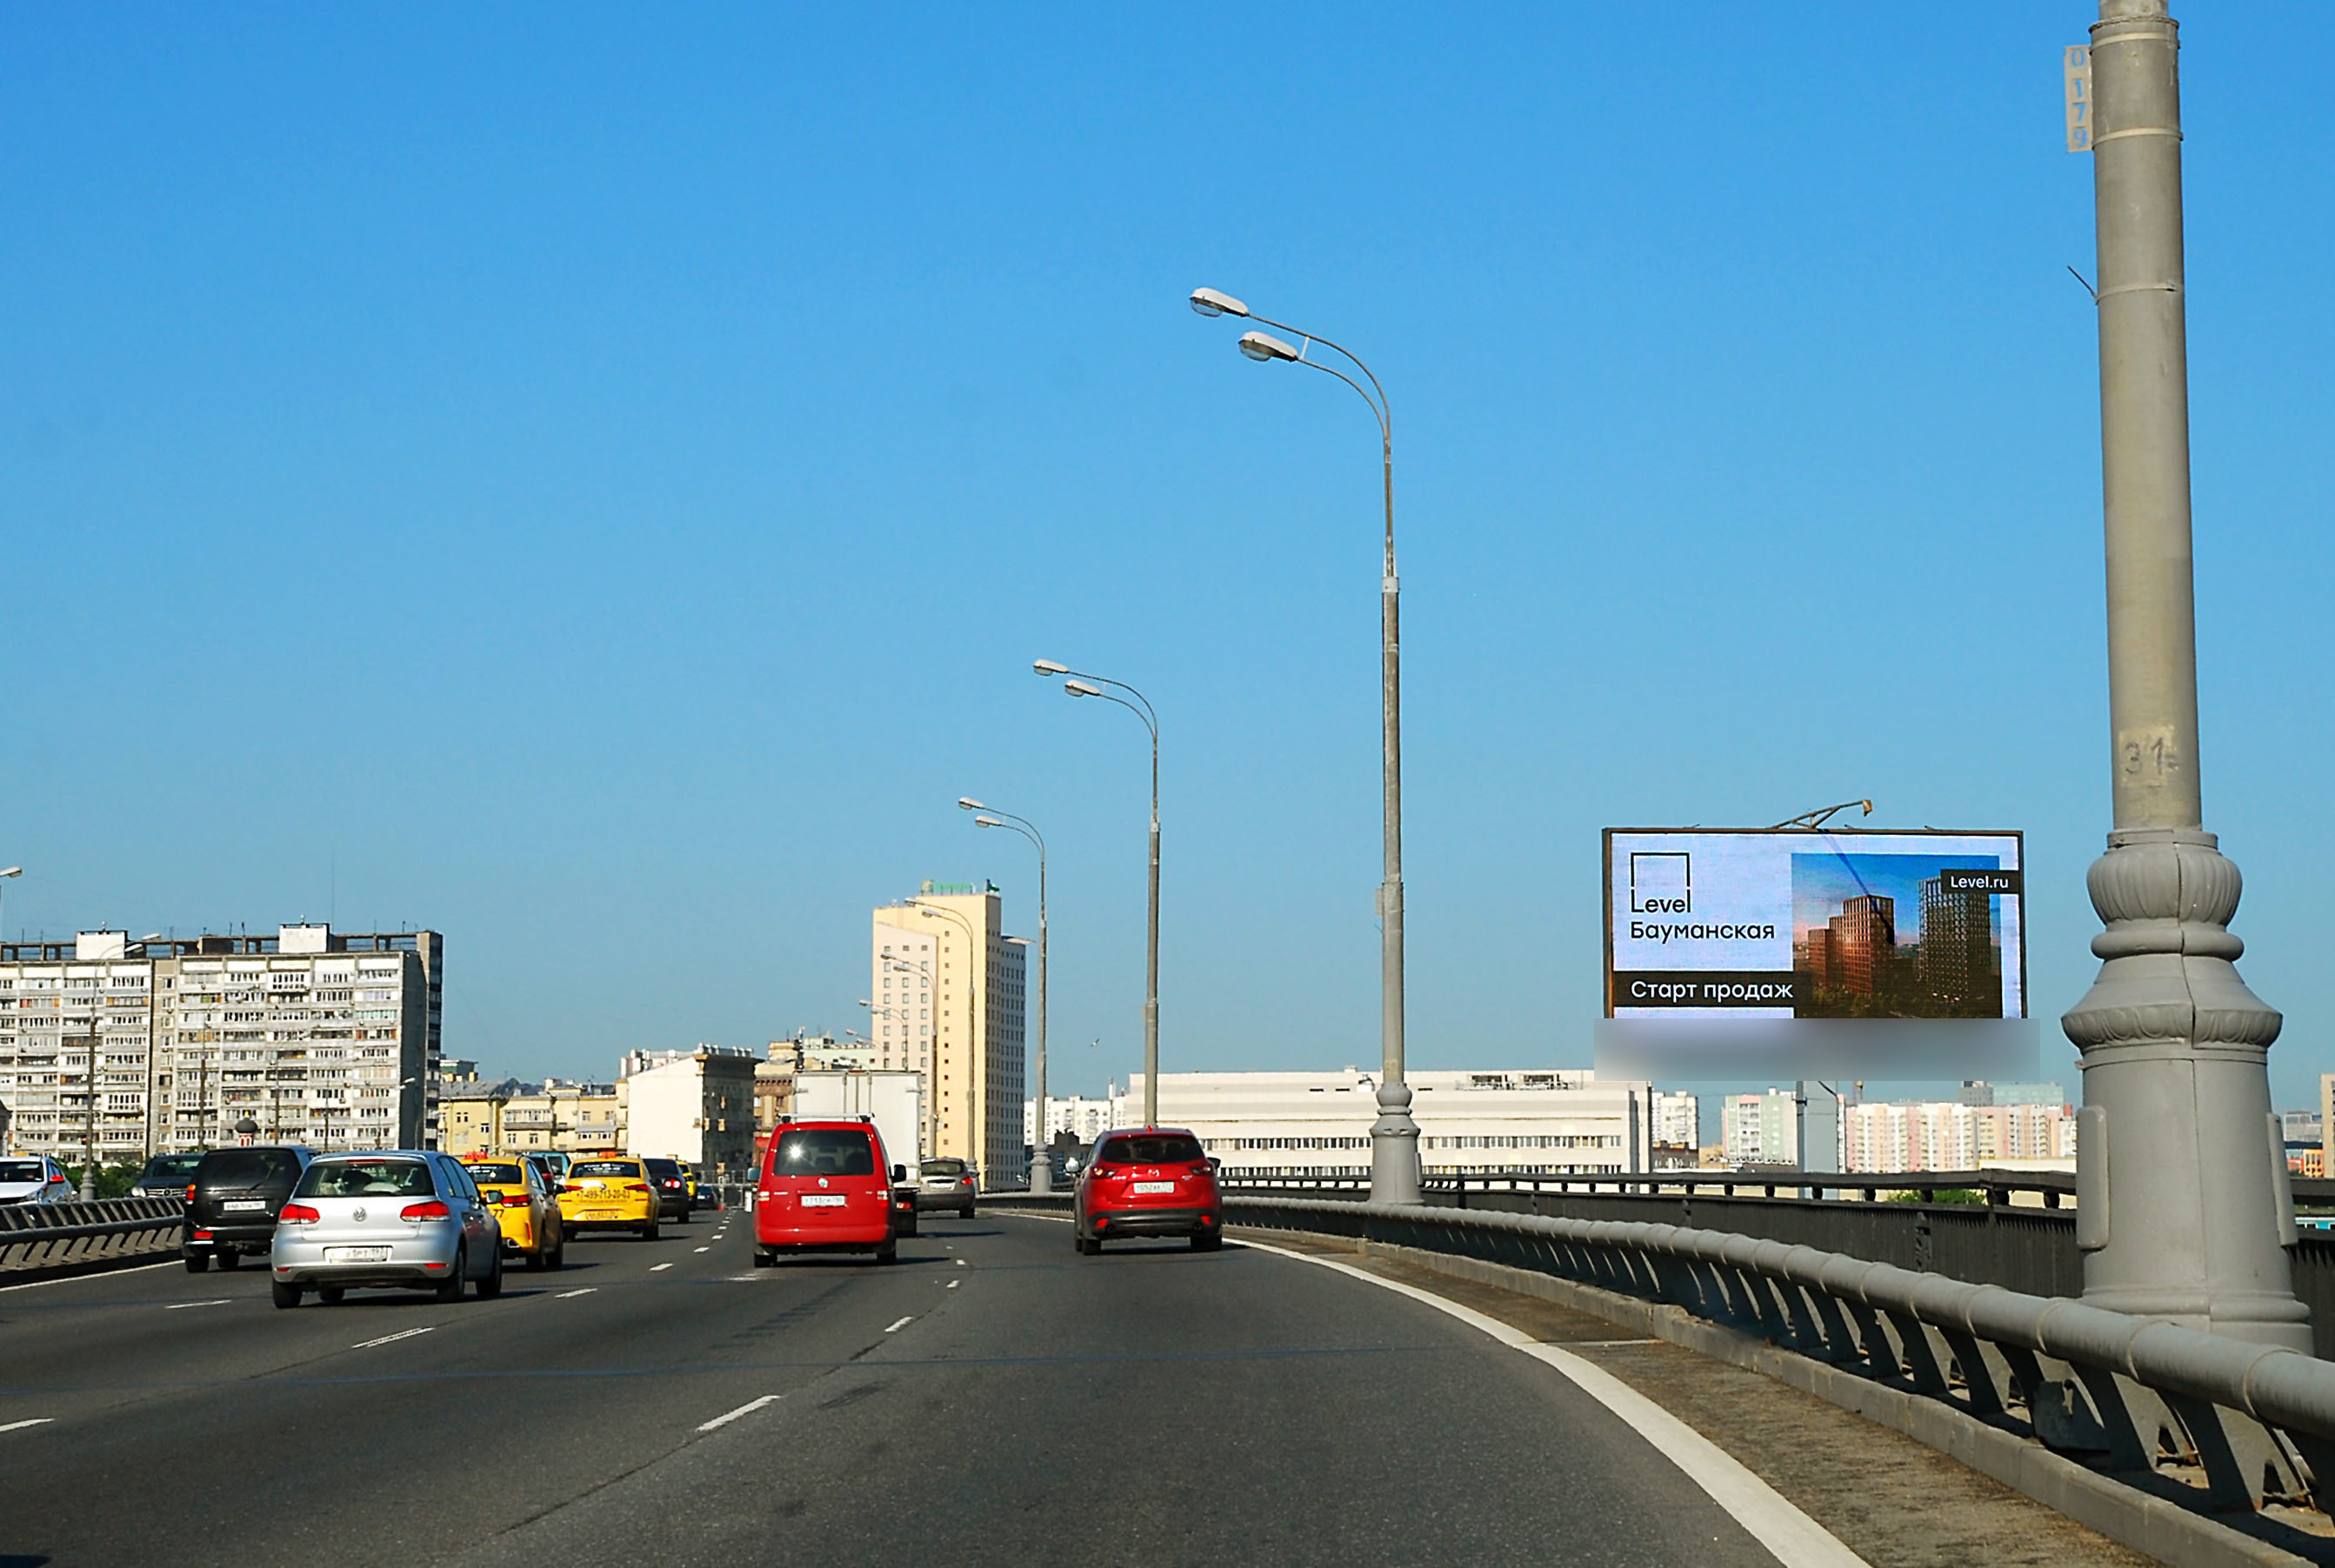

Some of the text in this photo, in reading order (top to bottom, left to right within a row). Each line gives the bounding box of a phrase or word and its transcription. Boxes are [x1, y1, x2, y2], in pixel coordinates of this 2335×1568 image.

[2071, 48, 2087, 148] 0179
[1951, 875, 2009, 889] Level.ru
[1631, 889, 1691, 913] Level
[1631, 921, 1775, 944] Бауманская
[1631, 981, 1794, 1003] Старт продаж
